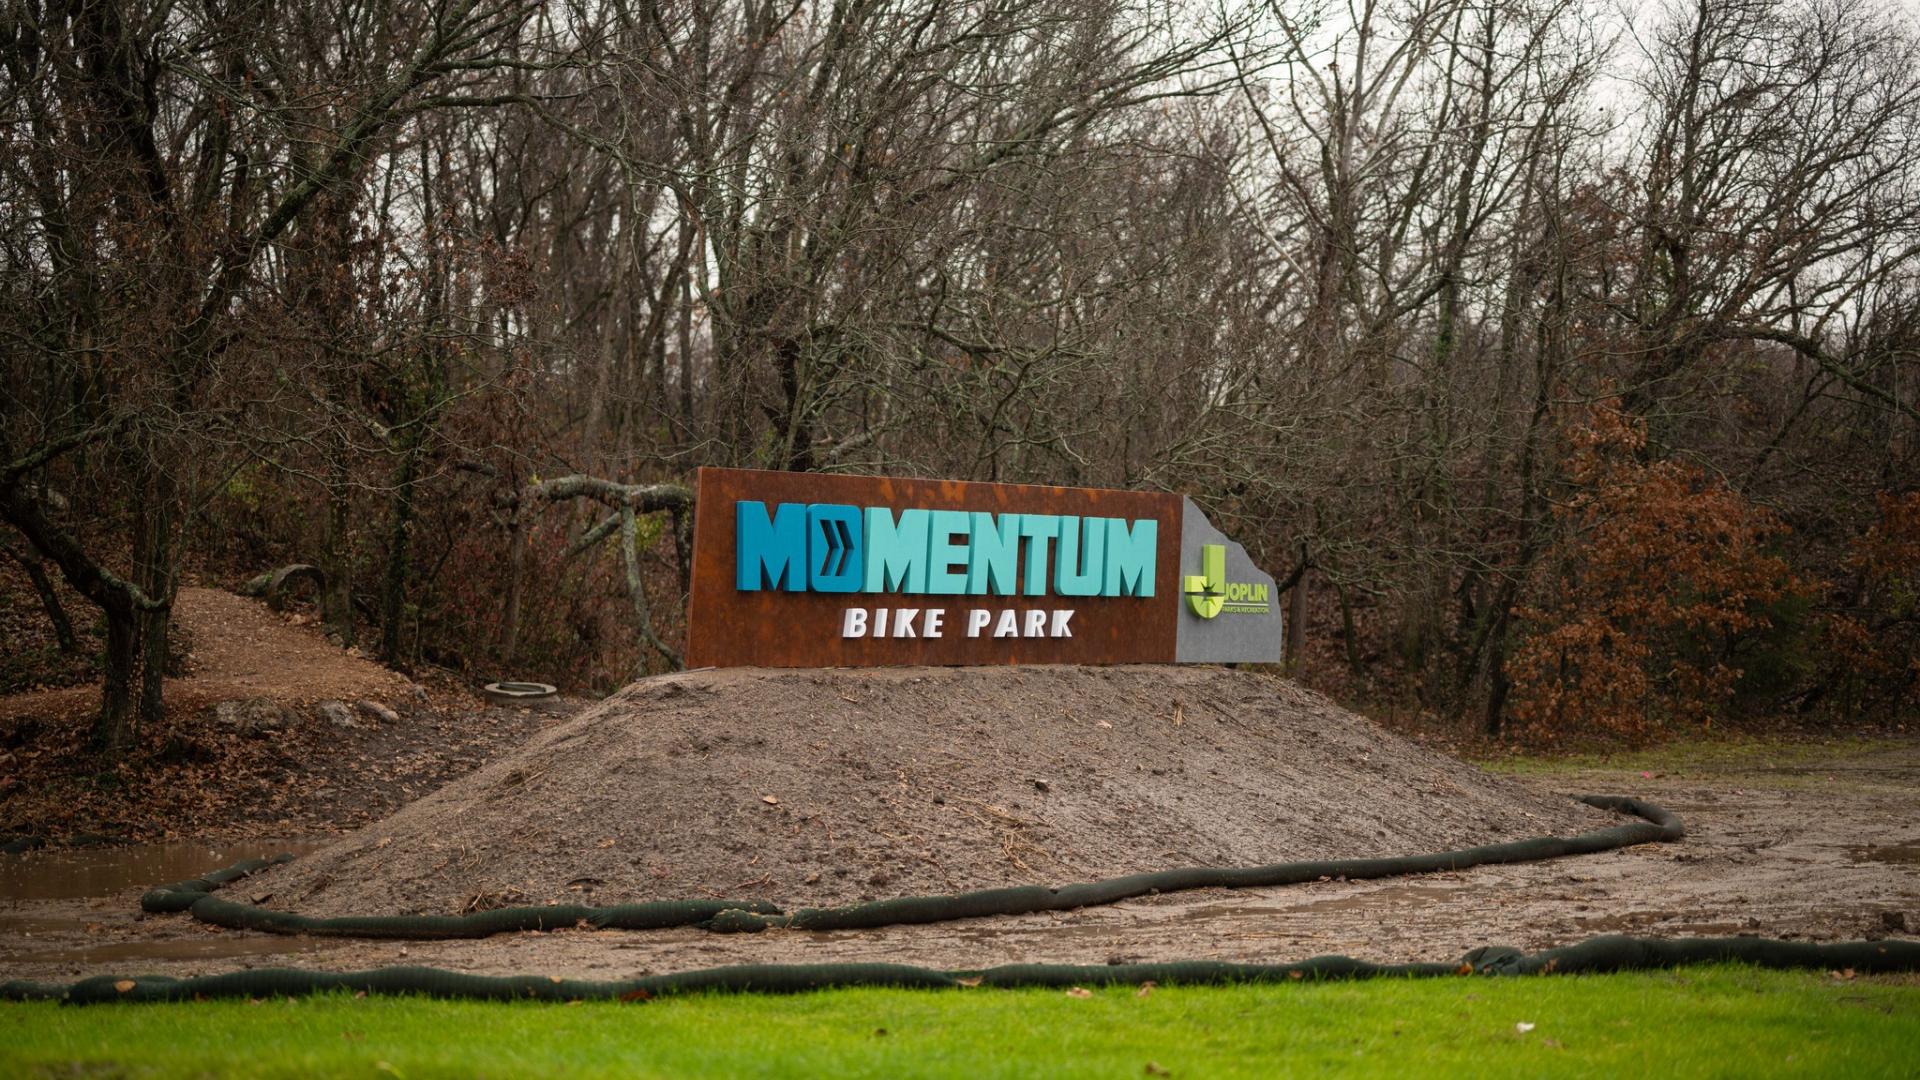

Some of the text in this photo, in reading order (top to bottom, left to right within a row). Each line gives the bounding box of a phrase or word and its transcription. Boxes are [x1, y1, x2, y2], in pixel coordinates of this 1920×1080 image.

[736, 500, 1158, 598] MOMENTUM
[1224, 583, 1268, 602] JOPLIN
[842, 608, 1075, 638] BIKE PARK
